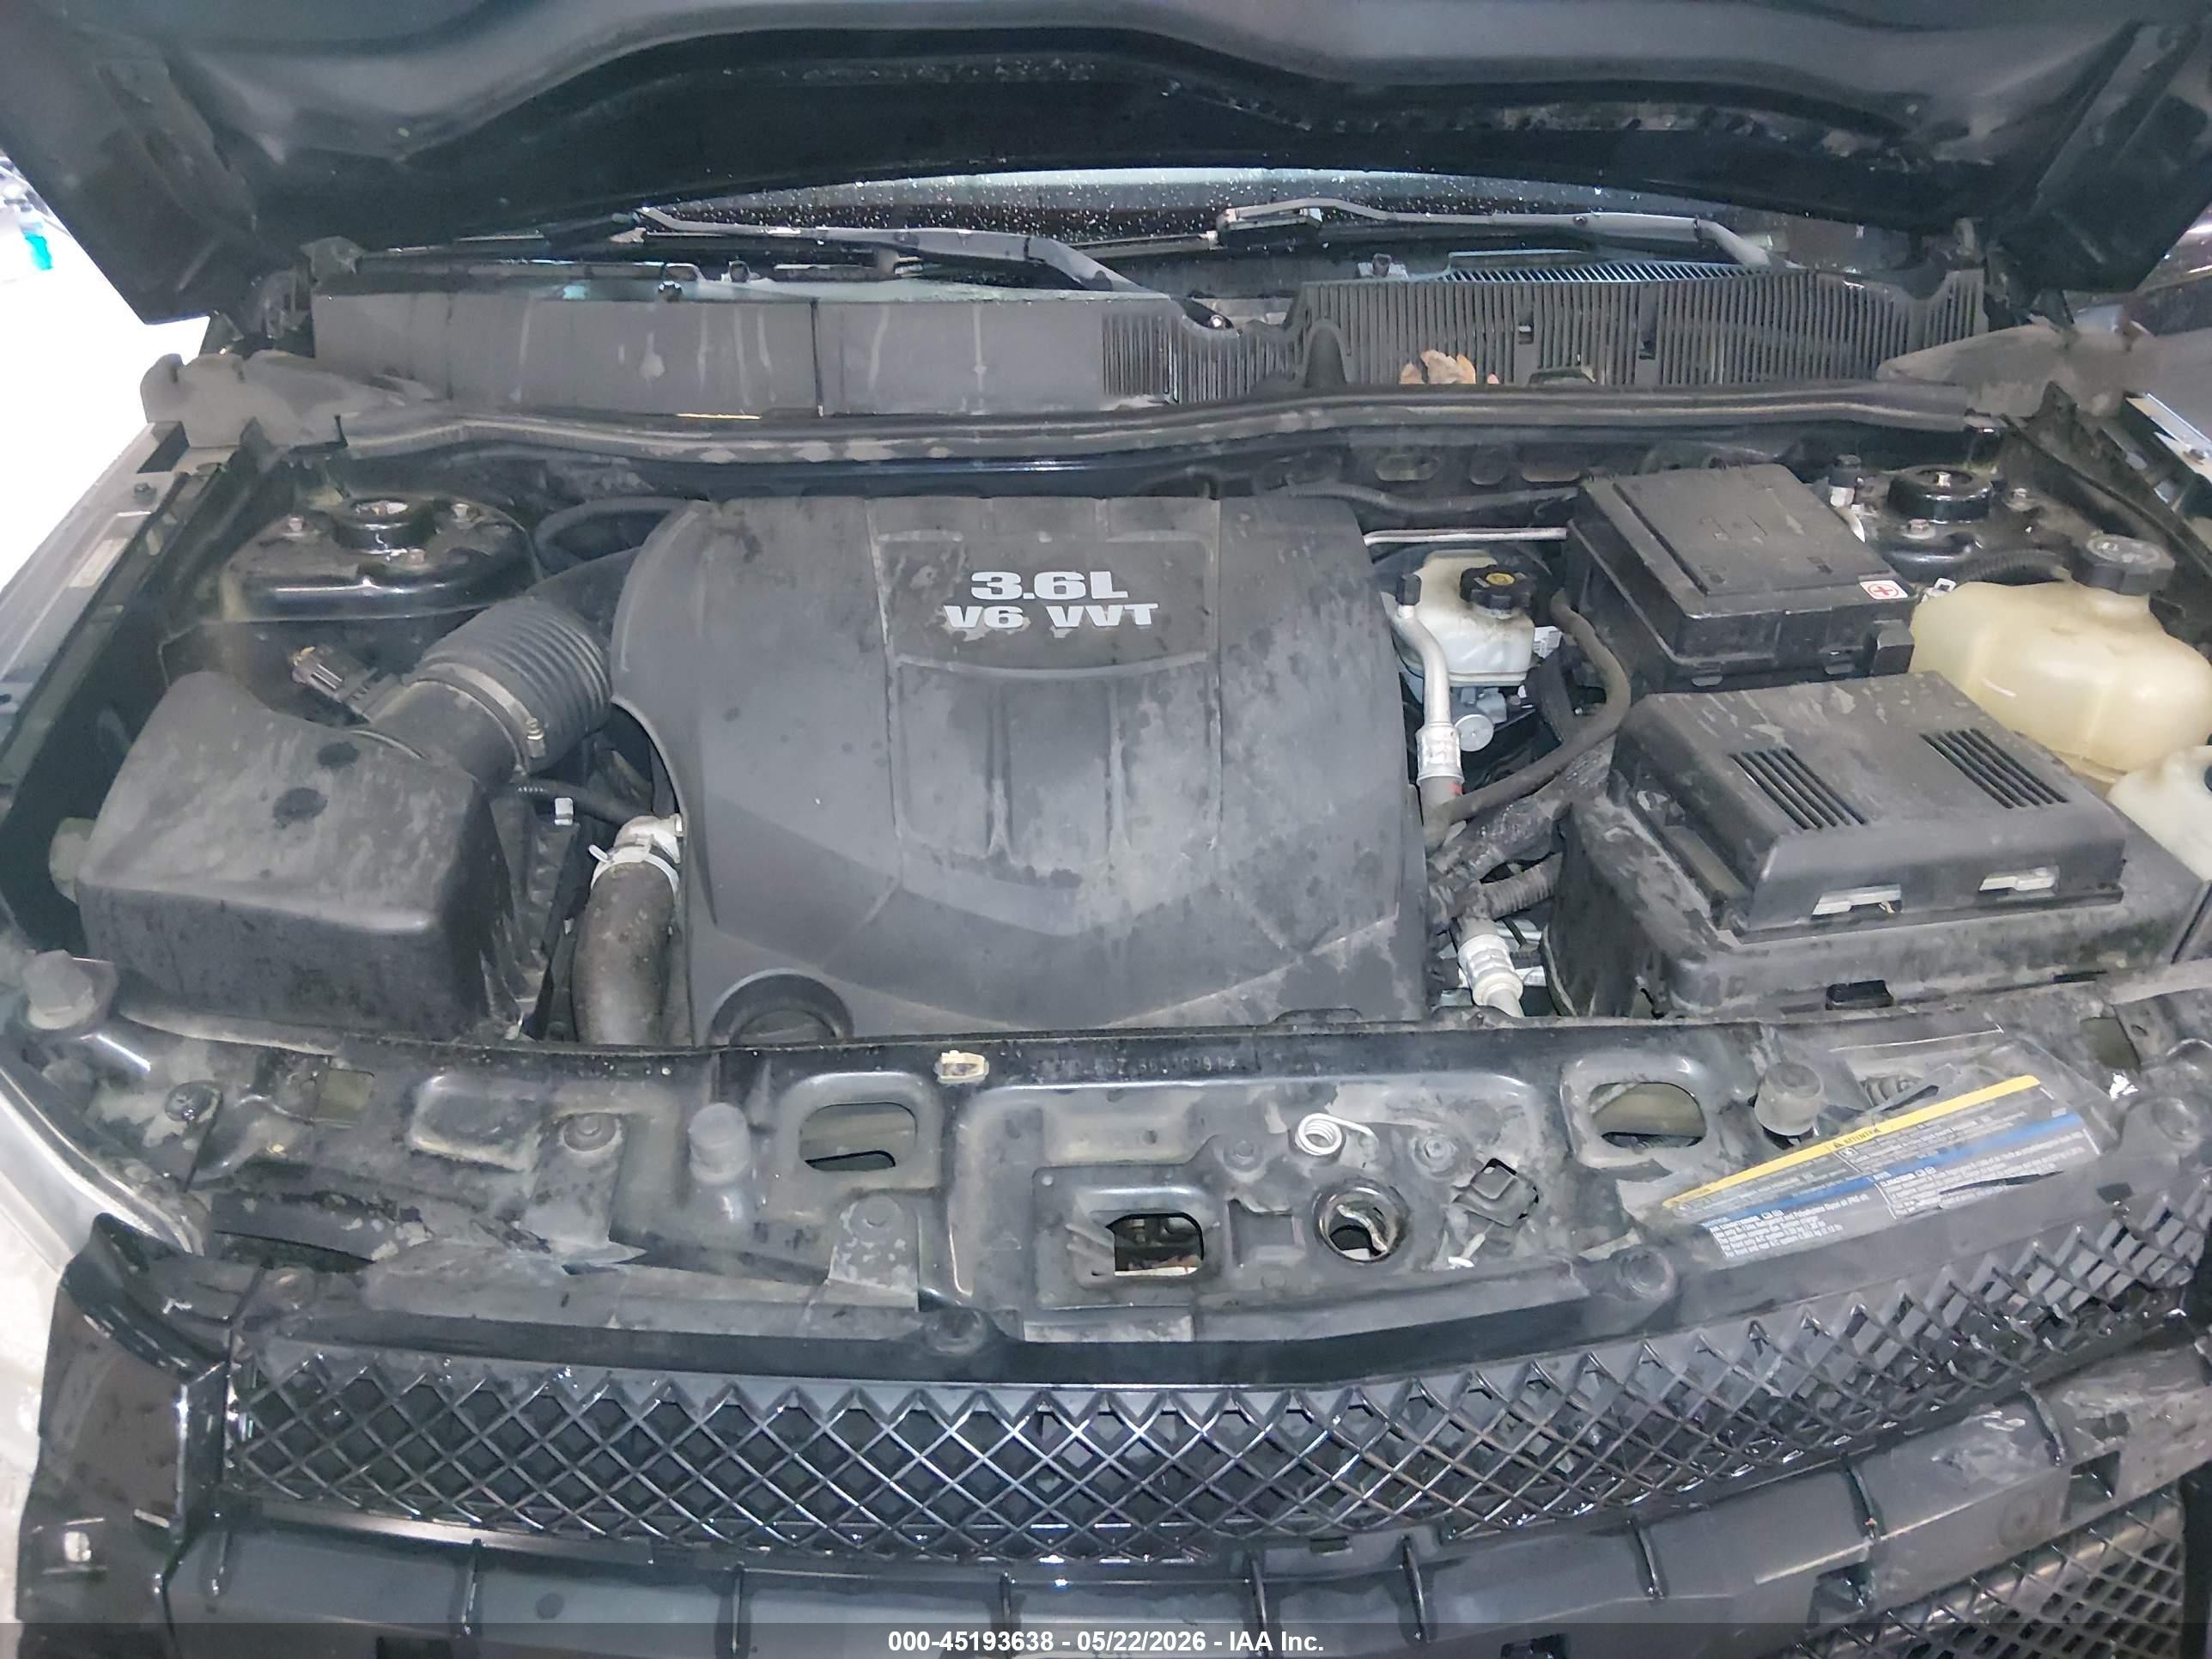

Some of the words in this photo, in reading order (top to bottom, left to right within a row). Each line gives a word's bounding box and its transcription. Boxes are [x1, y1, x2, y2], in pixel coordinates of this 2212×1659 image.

[970, 570, 1128, 600] 3.6L
[944, 605, 1024, 629] V6
[1045, 603, 1158, 628] VVT
